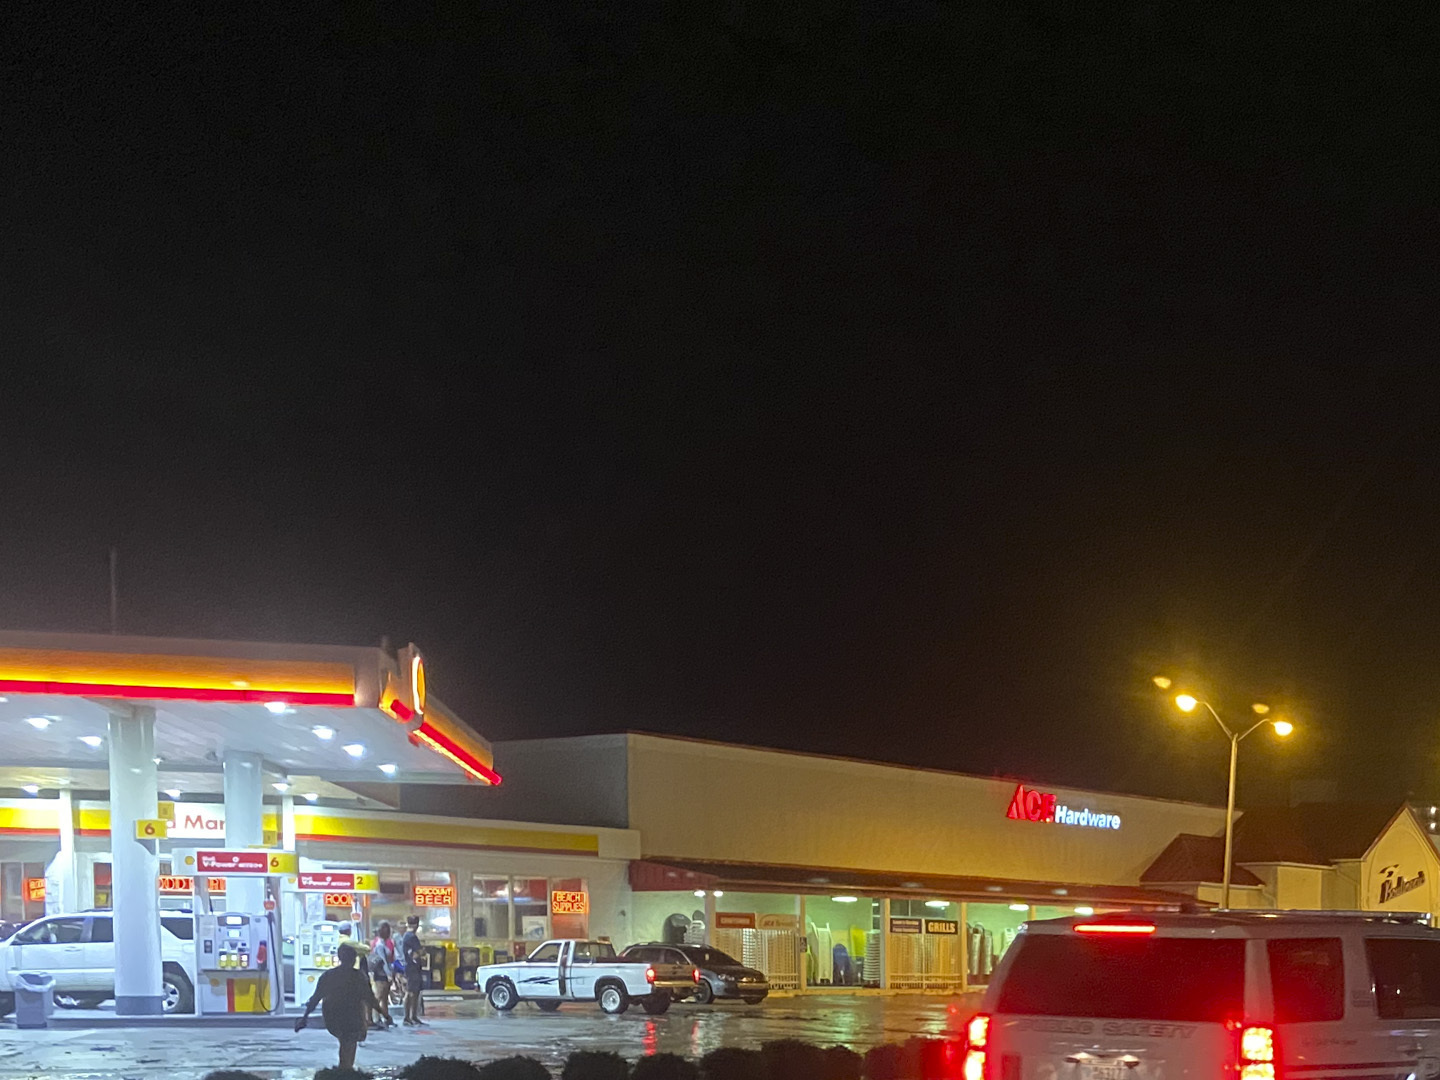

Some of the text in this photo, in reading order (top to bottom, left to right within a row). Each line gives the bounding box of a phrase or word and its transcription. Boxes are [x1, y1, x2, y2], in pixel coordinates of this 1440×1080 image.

[1006, 784, 1121, 830] ACE Hardware
[184, 815, 225, 830] Mar
[144, 823, 156, 835] 6
[270, 857, 279, 867] 6
[356, 876, 363, 885] 2
[415, 895, 451, 904] BEER
[928, 921, 955, 933] GRILLS
[1101, 1021, 1198, 1039] SAFETY
